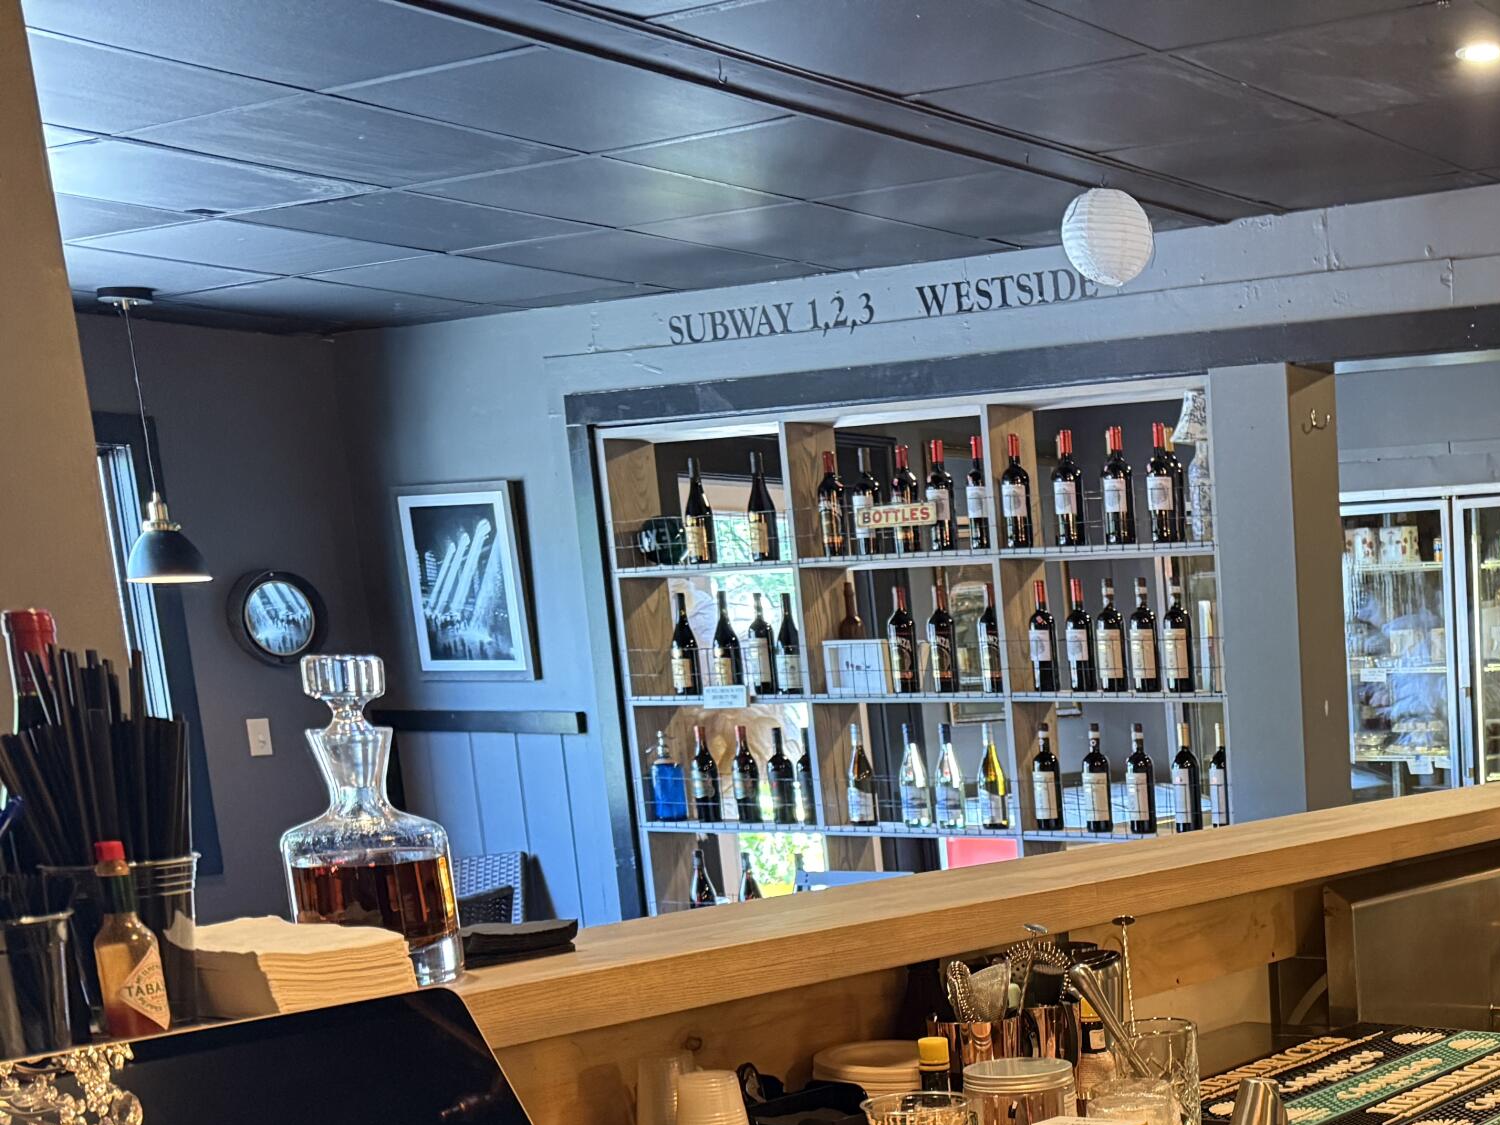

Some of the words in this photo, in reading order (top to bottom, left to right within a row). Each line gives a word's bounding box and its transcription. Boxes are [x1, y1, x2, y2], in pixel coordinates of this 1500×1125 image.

[668, 301, 794, 346] SUBWAY
[808, 292, 875, 335] 1,2,3
[915, 267, 1100, 318] WESTSIDE
[861, 507, 931, 526] BOTTLES
